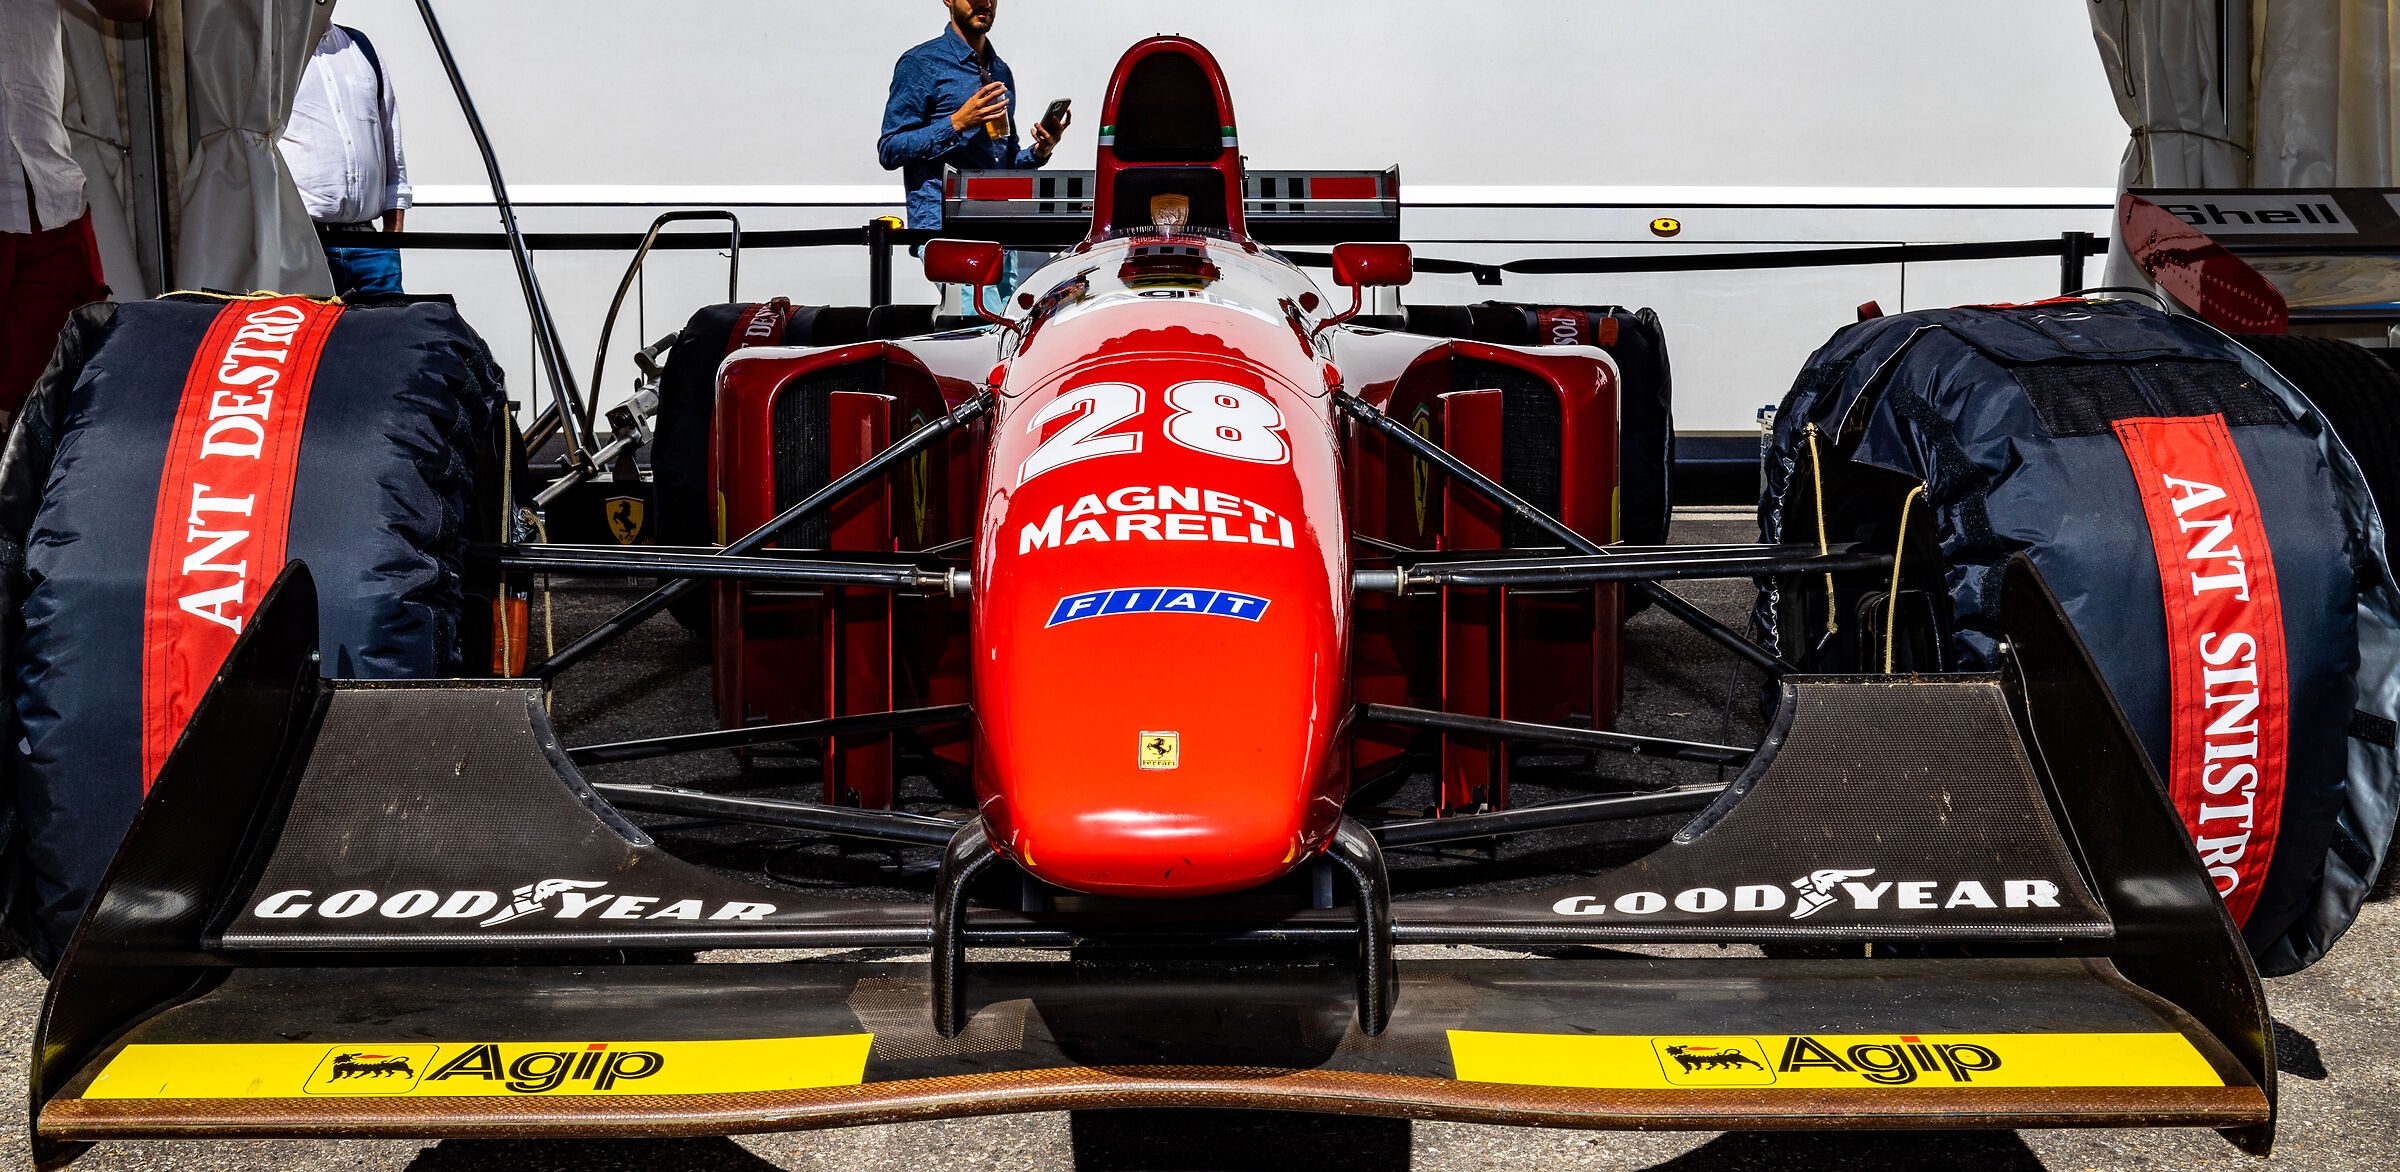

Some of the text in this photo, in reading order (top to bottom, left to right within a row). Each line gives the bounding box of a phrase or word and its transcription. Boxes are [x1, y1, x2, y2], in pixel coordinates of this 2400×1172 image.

[2158, 203, 2340, 225] Shell
[1016, 380, 1291, 489] 28
[178, 305, 306, 634] ANT DESTRO
[1019, 485, 1296, 546] MAGNETI
[1019, 504, 1296, 556] MARELLI
[2163, 473, 2250, 602] ANT
[1066, 592, 1256, 619] FIAT
[425, 1043, 665, 1092] Agip
[1777, 1035, 2002, 1084] Agip
